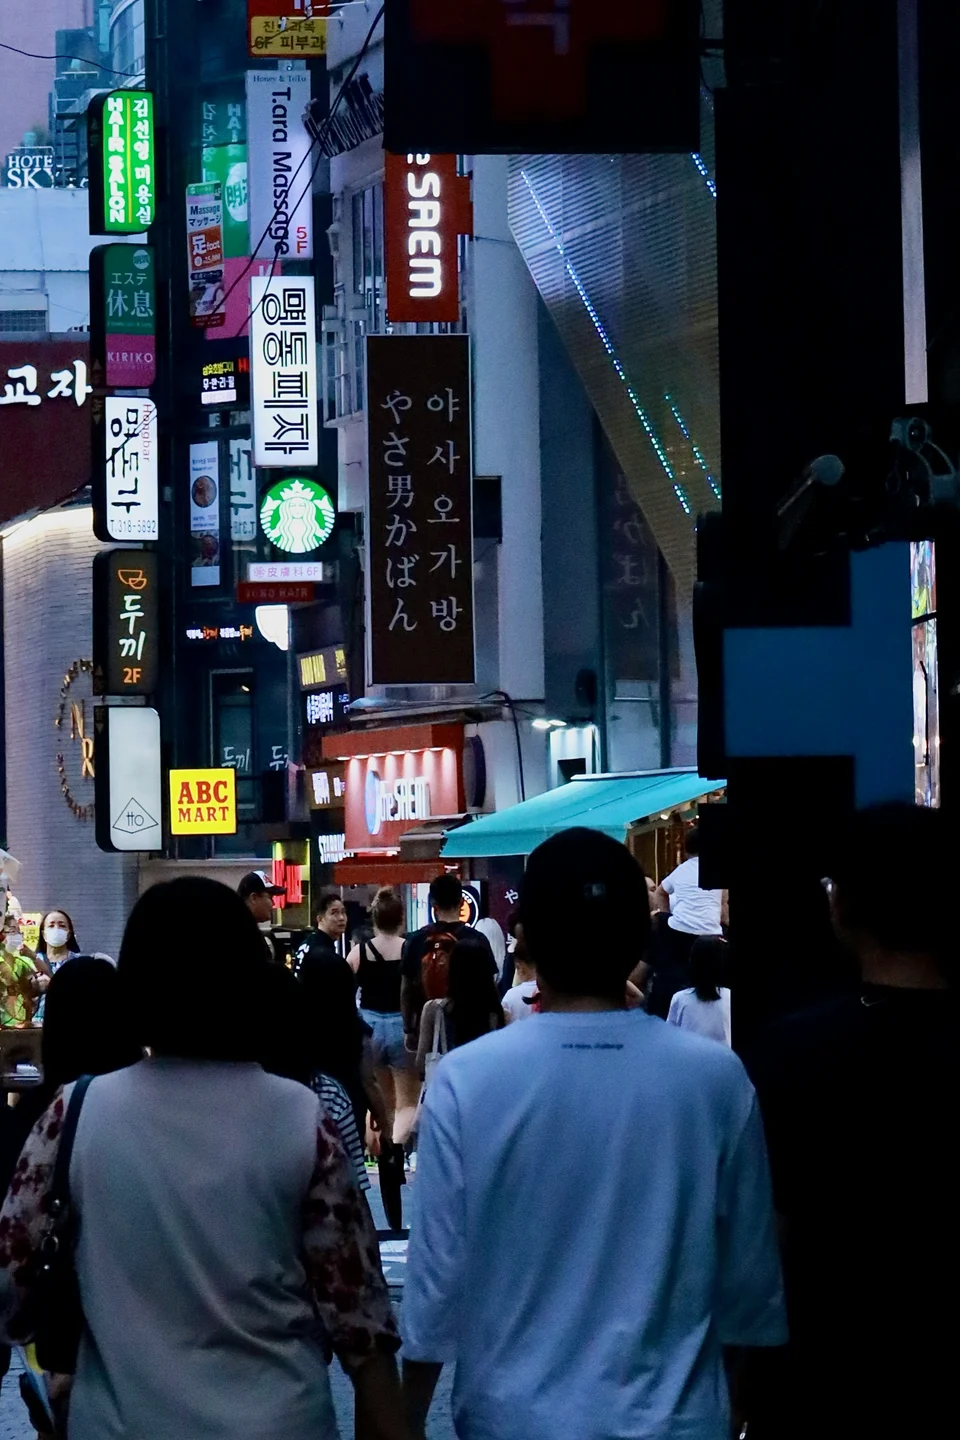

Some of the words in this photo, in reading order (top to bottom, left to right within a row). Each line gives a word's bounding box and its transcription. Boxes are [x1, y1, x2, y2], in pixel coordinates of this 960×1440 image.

[280, 35, 326, 50] 피부과
[107, 97, 125, 152] HAIR
[133, 98, 150, 161] 김선영
[271, 86, 291, 143] T.ara
[108, 155, 126, 224] SALON
[134, 163, 153, 225] 미용실
[190, 204, 221, 216] Massage
[269, 151, 292, 256] Massage
[192, 234, 207, 256] 足
[296, 226, 308, 254] 5F
[406, 171, 443, 299] SAEM
[105, 288, 154, 318] 休息
[111, 272, 148, 286] エステ
[107, 351, 154, 363] KIRIKO
[261, 287, 310, 456] 명동피자
[141, 403, 153, 462] Hongbar
[380, 389, 419, 634] やさ男かばん
[426, 386, 464, 633] 야사오가방
[306, 567, 319, 577] 6F
[118, 594, 146, 661] 두끼
[122, 667, 142, 684] 2F
[177, 780, 228, 805] ABC
[178, 806, 230, 823] MART
